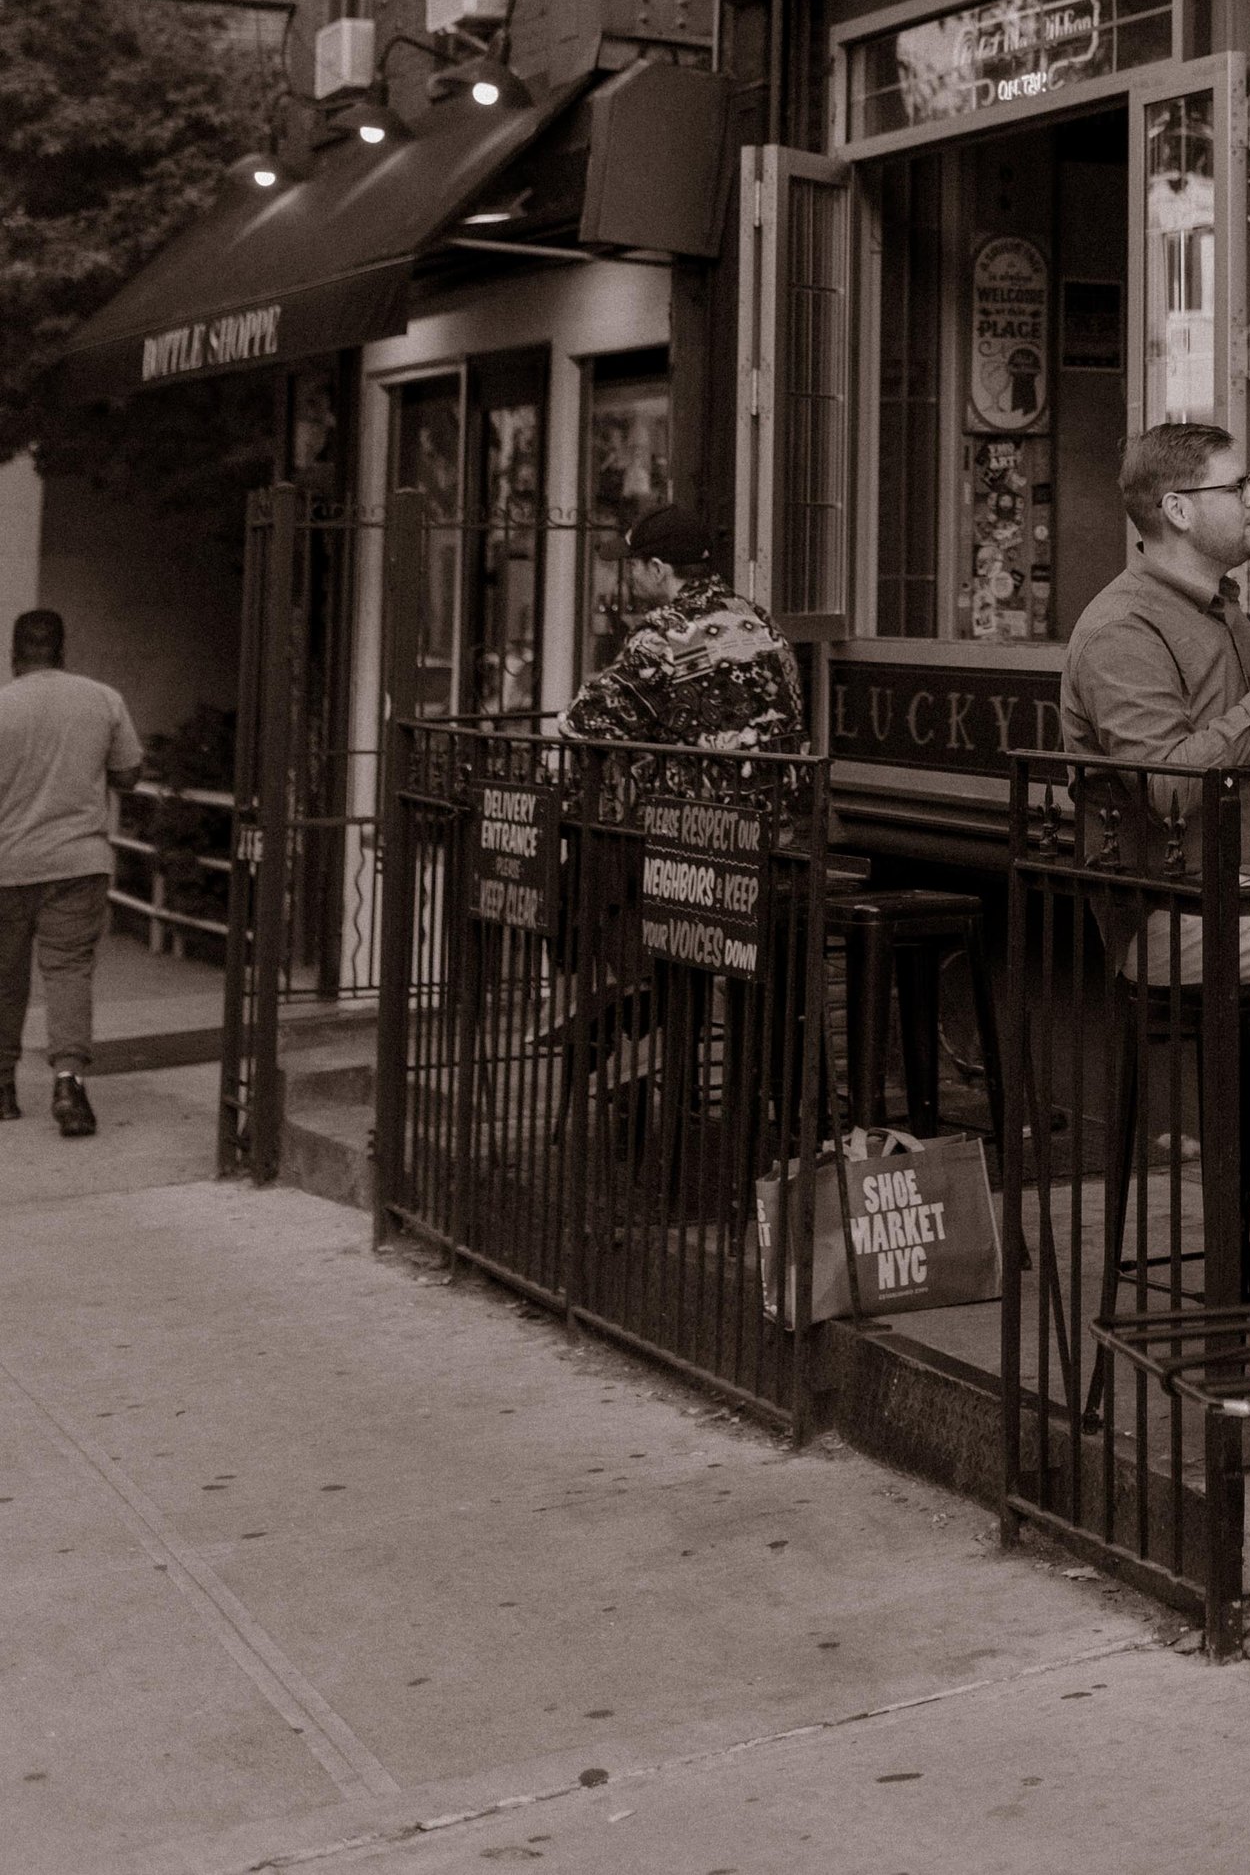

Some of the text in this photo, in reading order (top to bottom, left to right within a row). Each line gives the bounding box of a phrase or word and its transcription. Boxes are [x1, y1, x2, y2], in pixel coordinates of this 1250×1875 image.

[978, 287, 1045, 304] WELCOME
[977, 320, 1042, 339] PLACE
[484, 788, 537, 824] DELIVERY
[645, 805, 761, 852] PLEASE RESPECT OUR
[482, 819, 538, 858] ENTRANCE
[480, 878, 538, 929] KEEP CLEAR
[643, 856, 716, 907] NEIGHBORS
[724, 873, 759, 915] KEEP
[642, 918, 758, 972] YOUR VOICES DOWN
[862, 1169, 923, 1214] SHOE
[849, 1202, 947, 1256] MARKET
[878, 1246, 930, 1291] NYC
